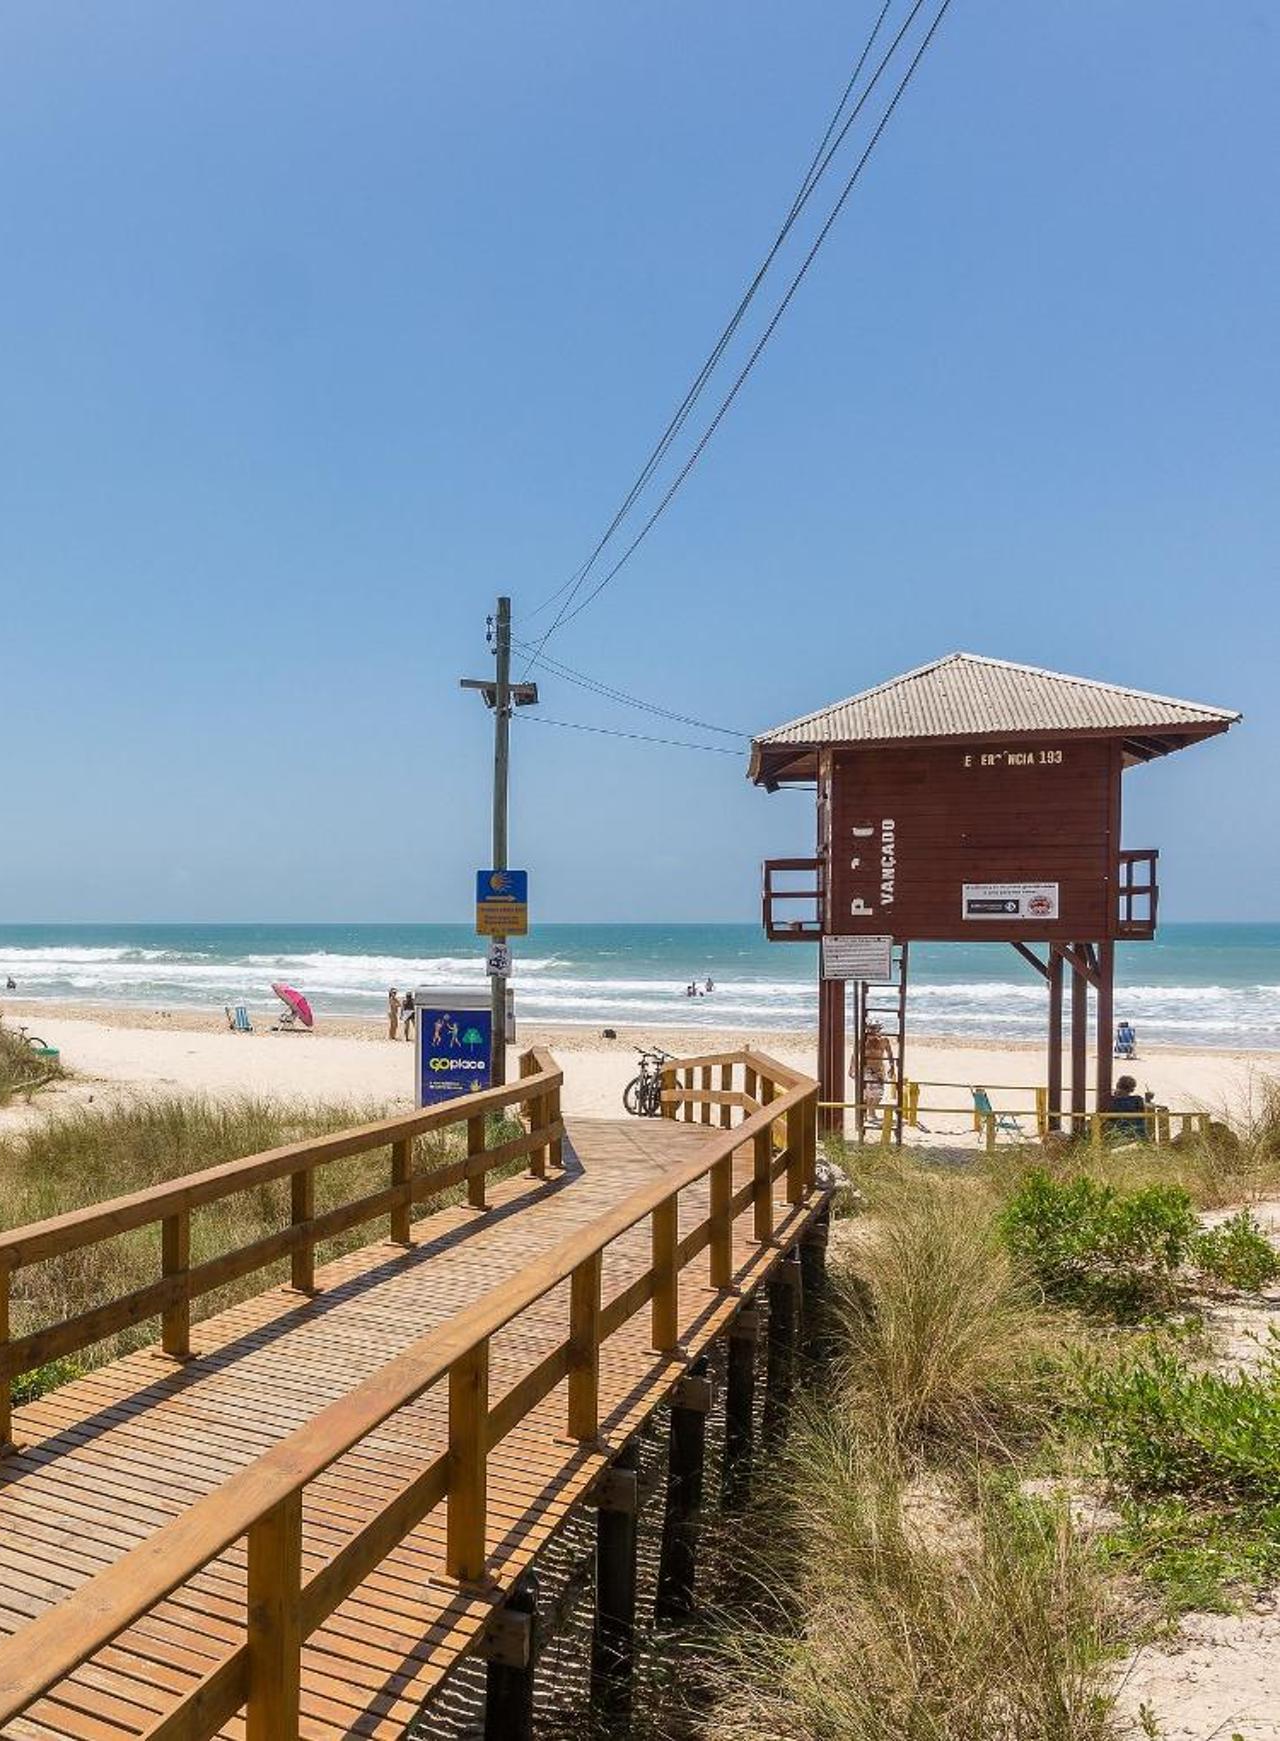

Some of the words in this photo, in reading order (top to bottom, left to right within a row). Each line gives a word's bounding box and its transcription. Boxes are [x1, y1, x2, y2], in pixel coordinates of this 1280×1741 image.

[964, 750, 1035, 767] EERNCIA
[1039, 750, 1063, 764] 193
[880, 819, 896, 908] VANÇADO
